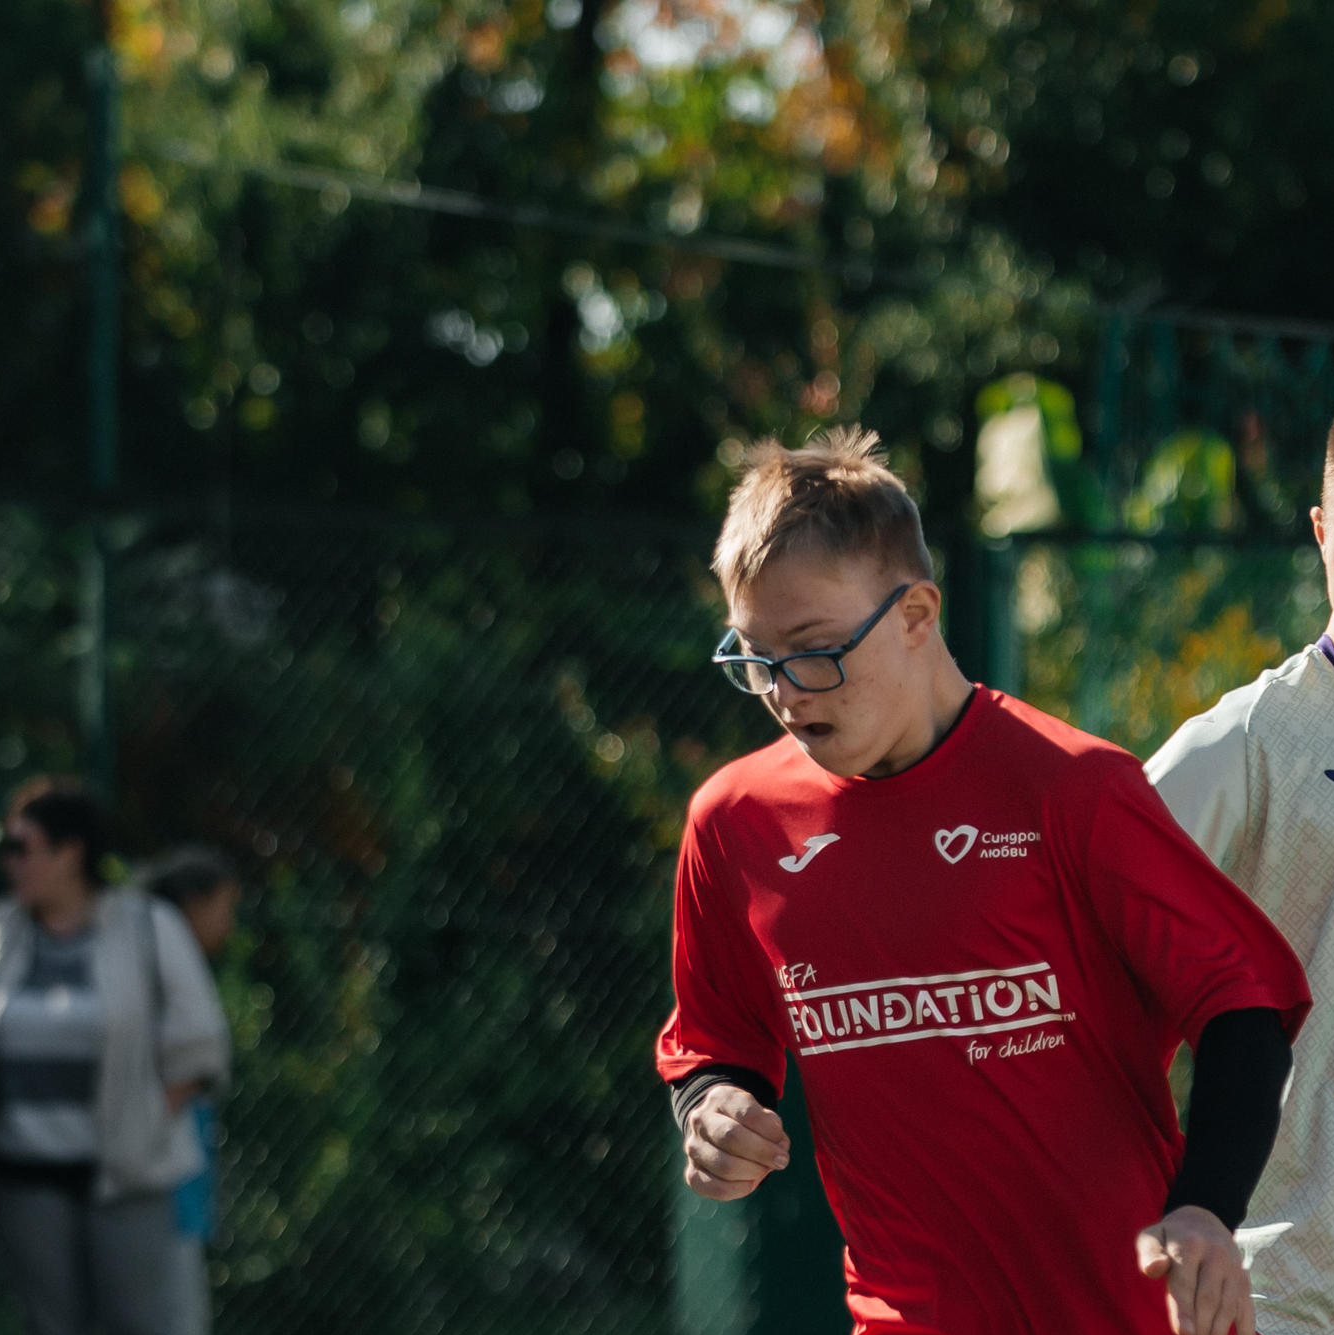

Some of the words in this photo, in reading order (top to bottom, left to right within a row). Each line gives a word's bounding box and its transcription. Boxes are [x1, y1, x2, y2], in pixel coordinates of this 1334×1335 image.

[980, 845, 1028, 858] любви
[967, 1040, 993, 1066] for
[999, 1031, 1066, 1058] children
